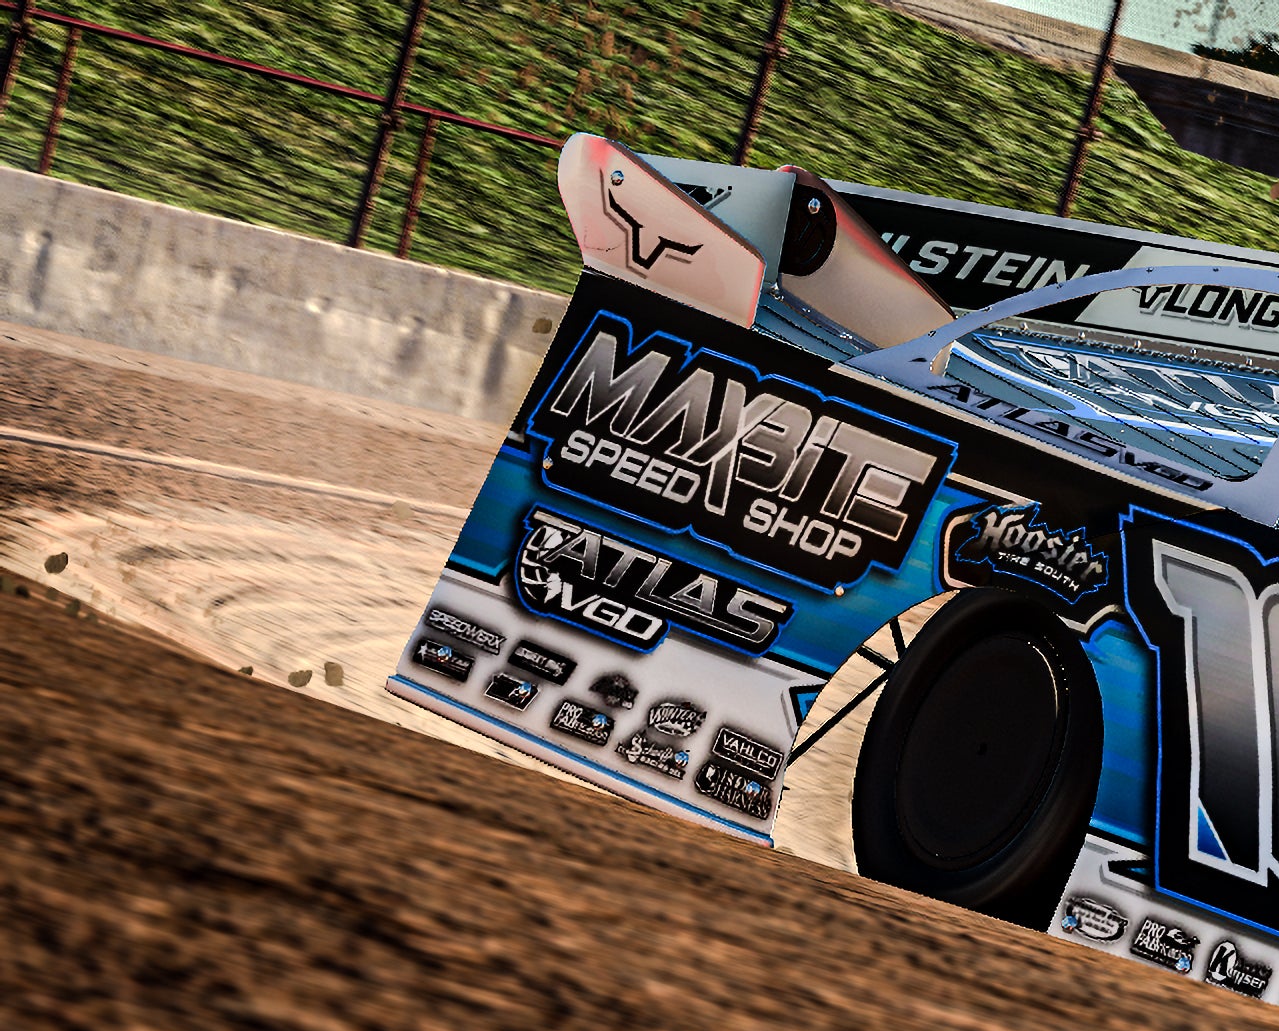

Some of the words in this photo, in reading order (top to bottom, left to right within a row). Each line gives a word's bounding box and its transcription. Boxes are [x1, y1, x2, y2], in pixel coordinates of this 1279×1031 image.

[881, 232, 1091, 291] STEIN
[551, 332, 937, 540] MAXBITE
[560, 431, 699, 504] SPEED
[743, 499, 862, 563] SHOP
[534, 511, 787, 643] ATLAS
[975, 512, 1102, 582] Hoosier
[557, 582, 664, 639] VGD
[722, 733, 778, 767] VAHLCO
[1141, 919, 1166, 939] PRO
